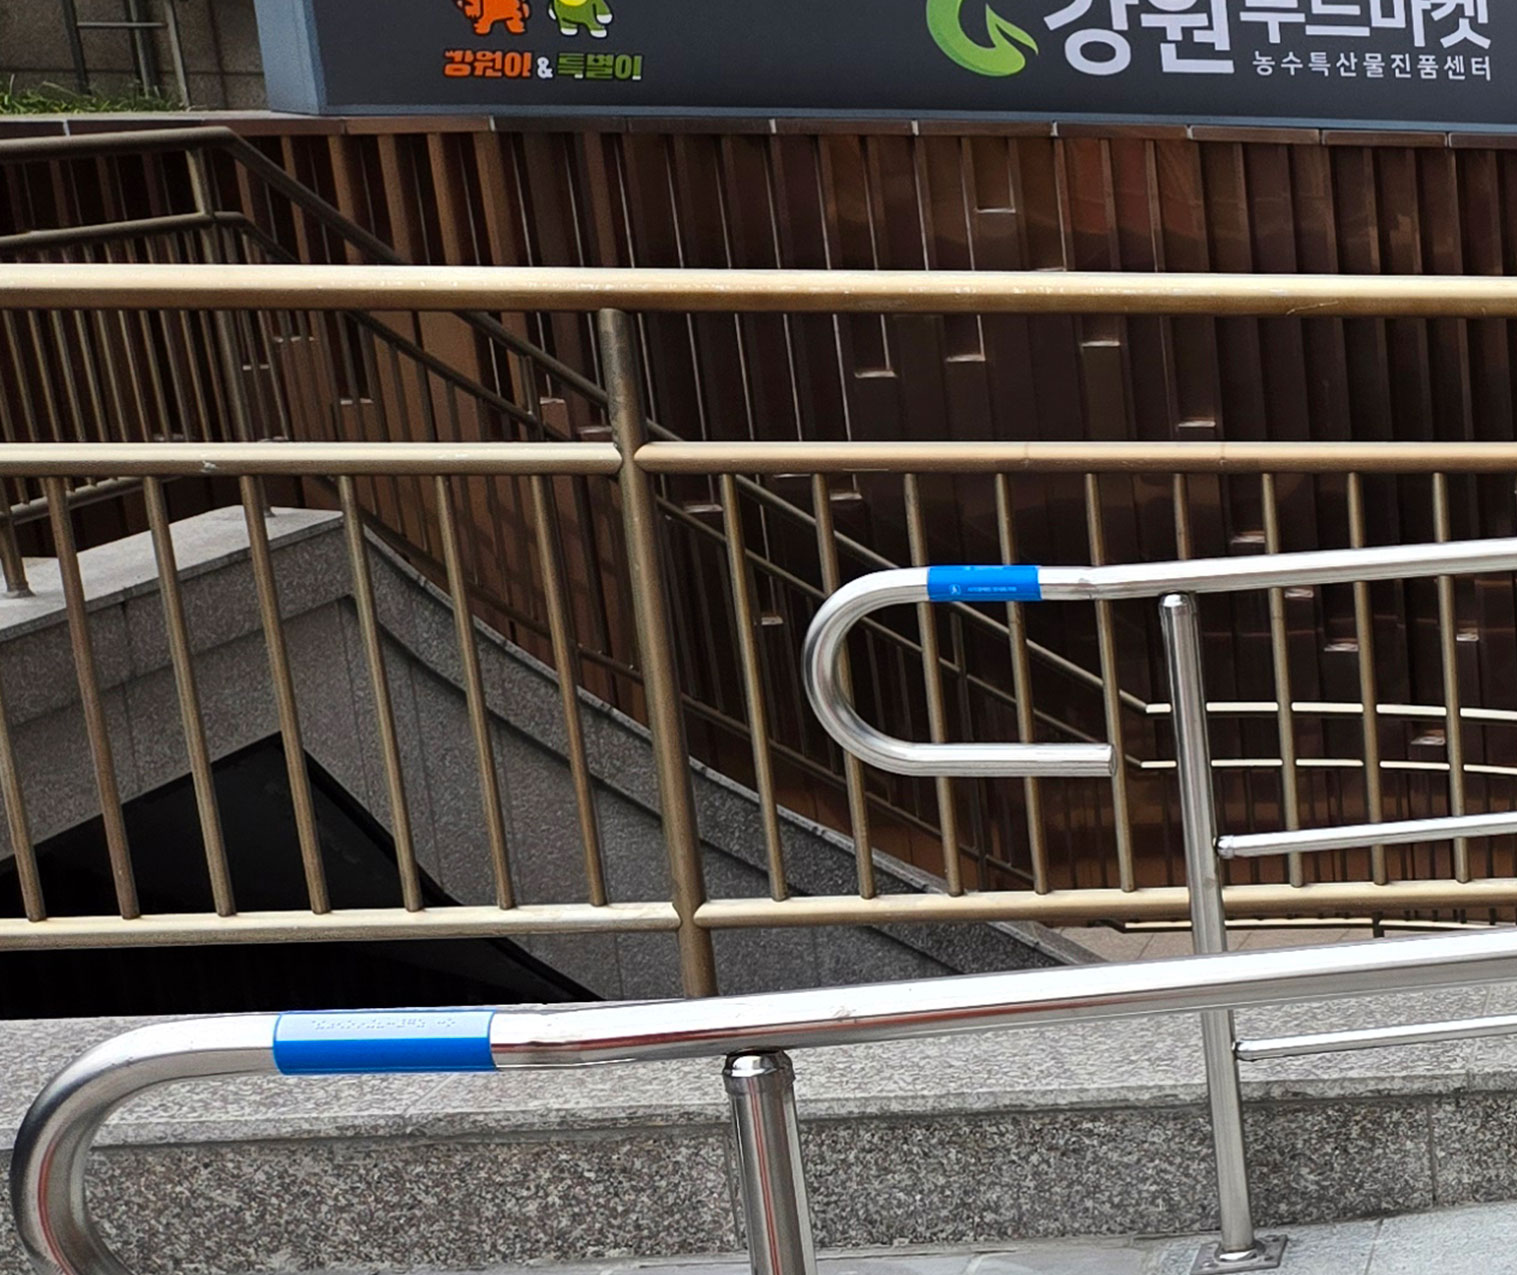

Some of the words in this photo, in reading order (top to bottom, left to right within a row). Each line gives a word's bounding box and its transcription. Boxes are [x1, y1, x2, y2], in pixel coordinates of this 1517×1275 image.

[444, 50, 532, 78] 강원이
[537, 57, 553, 78] &
[558, 52, 642, 80] 특별이
[1252, 50, 1491, 81] 농수특산물진품센터
